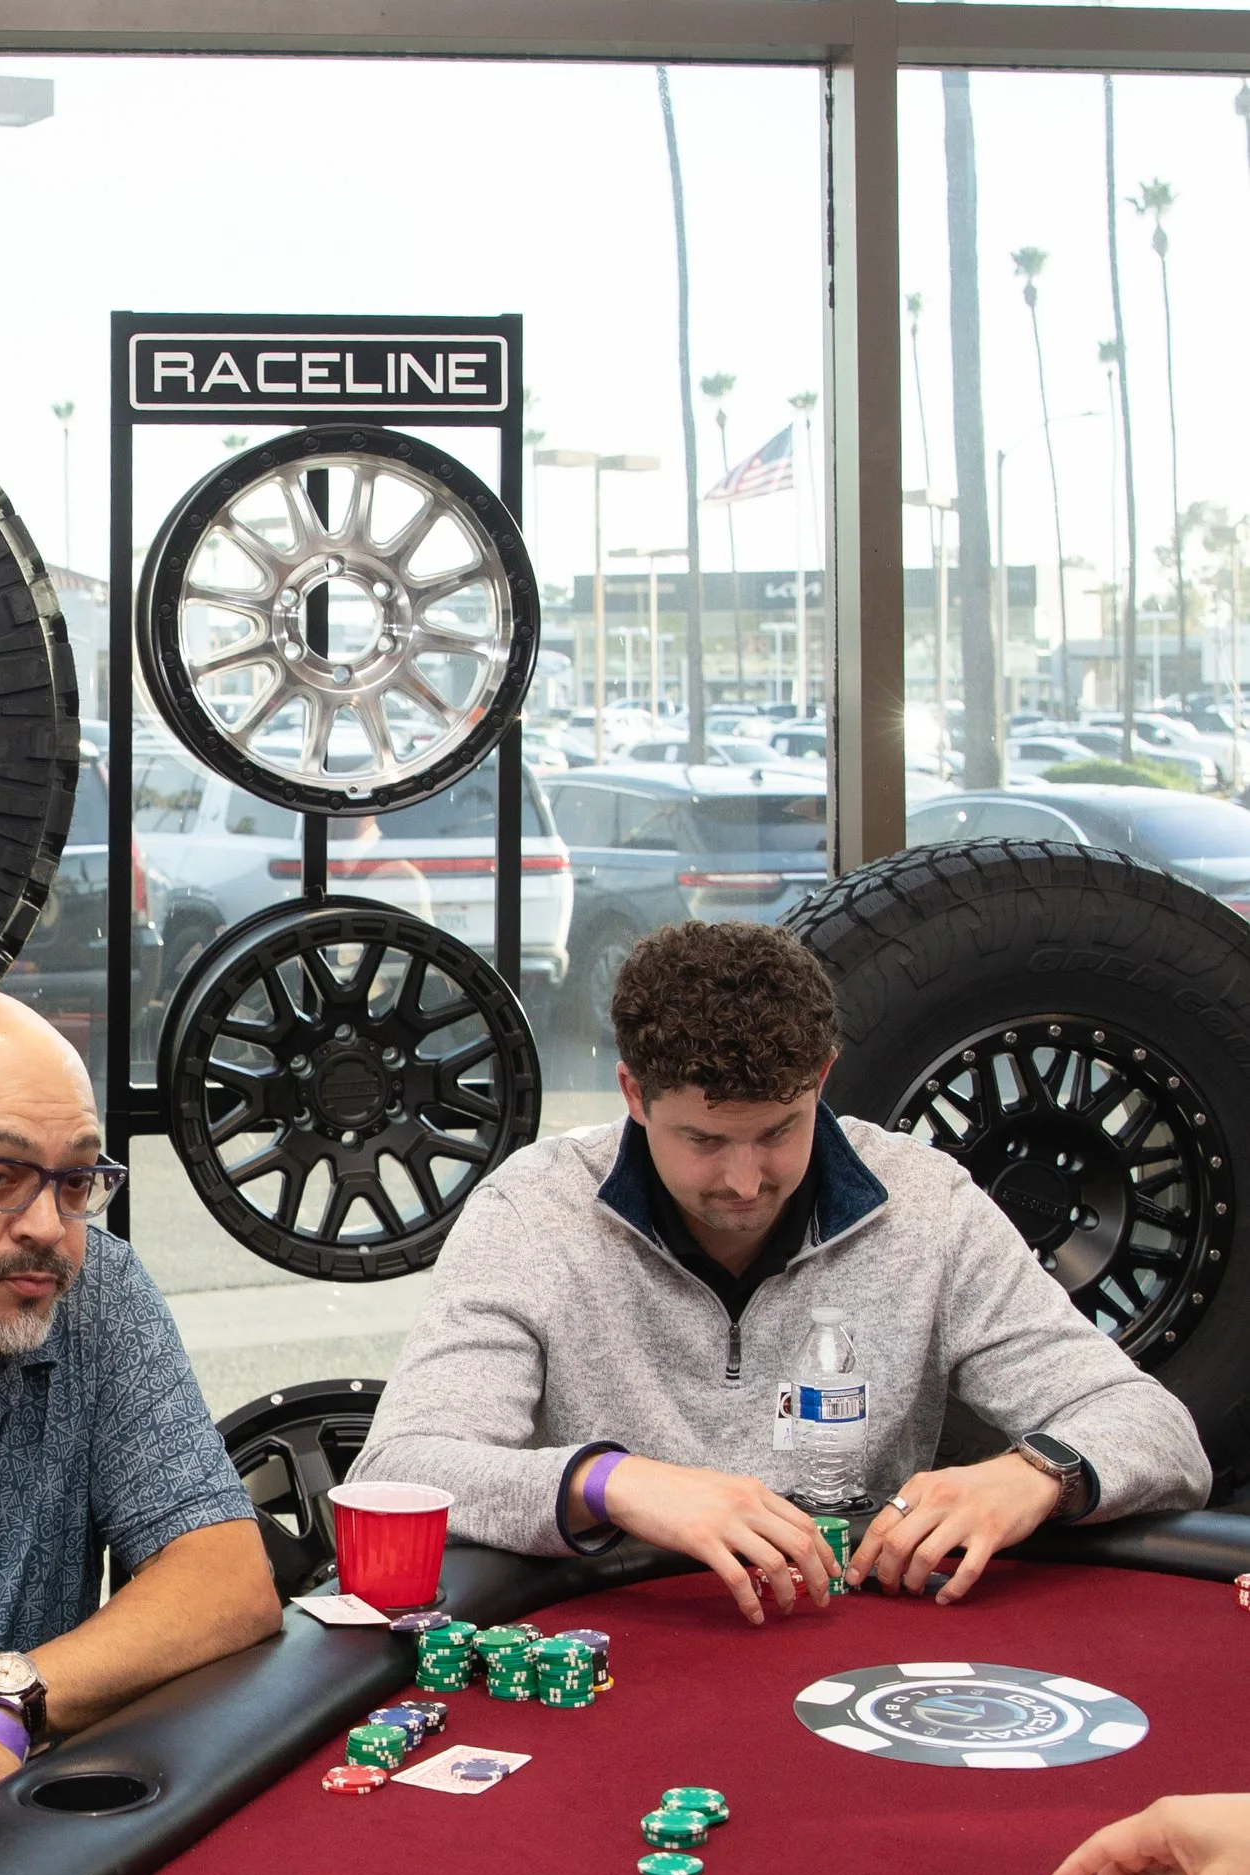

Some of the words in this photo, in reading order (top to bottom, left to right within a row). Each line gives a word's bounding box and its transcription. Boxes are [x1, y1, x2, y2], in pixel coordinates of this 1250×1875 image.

[153, 351, 487, 394] RACELINE
[1028, 948, 1172, 994] OPEN
[884, 1687, 954, 1729] GLOBAL
[964, 1693, 1058, 1741] GATEWAY
